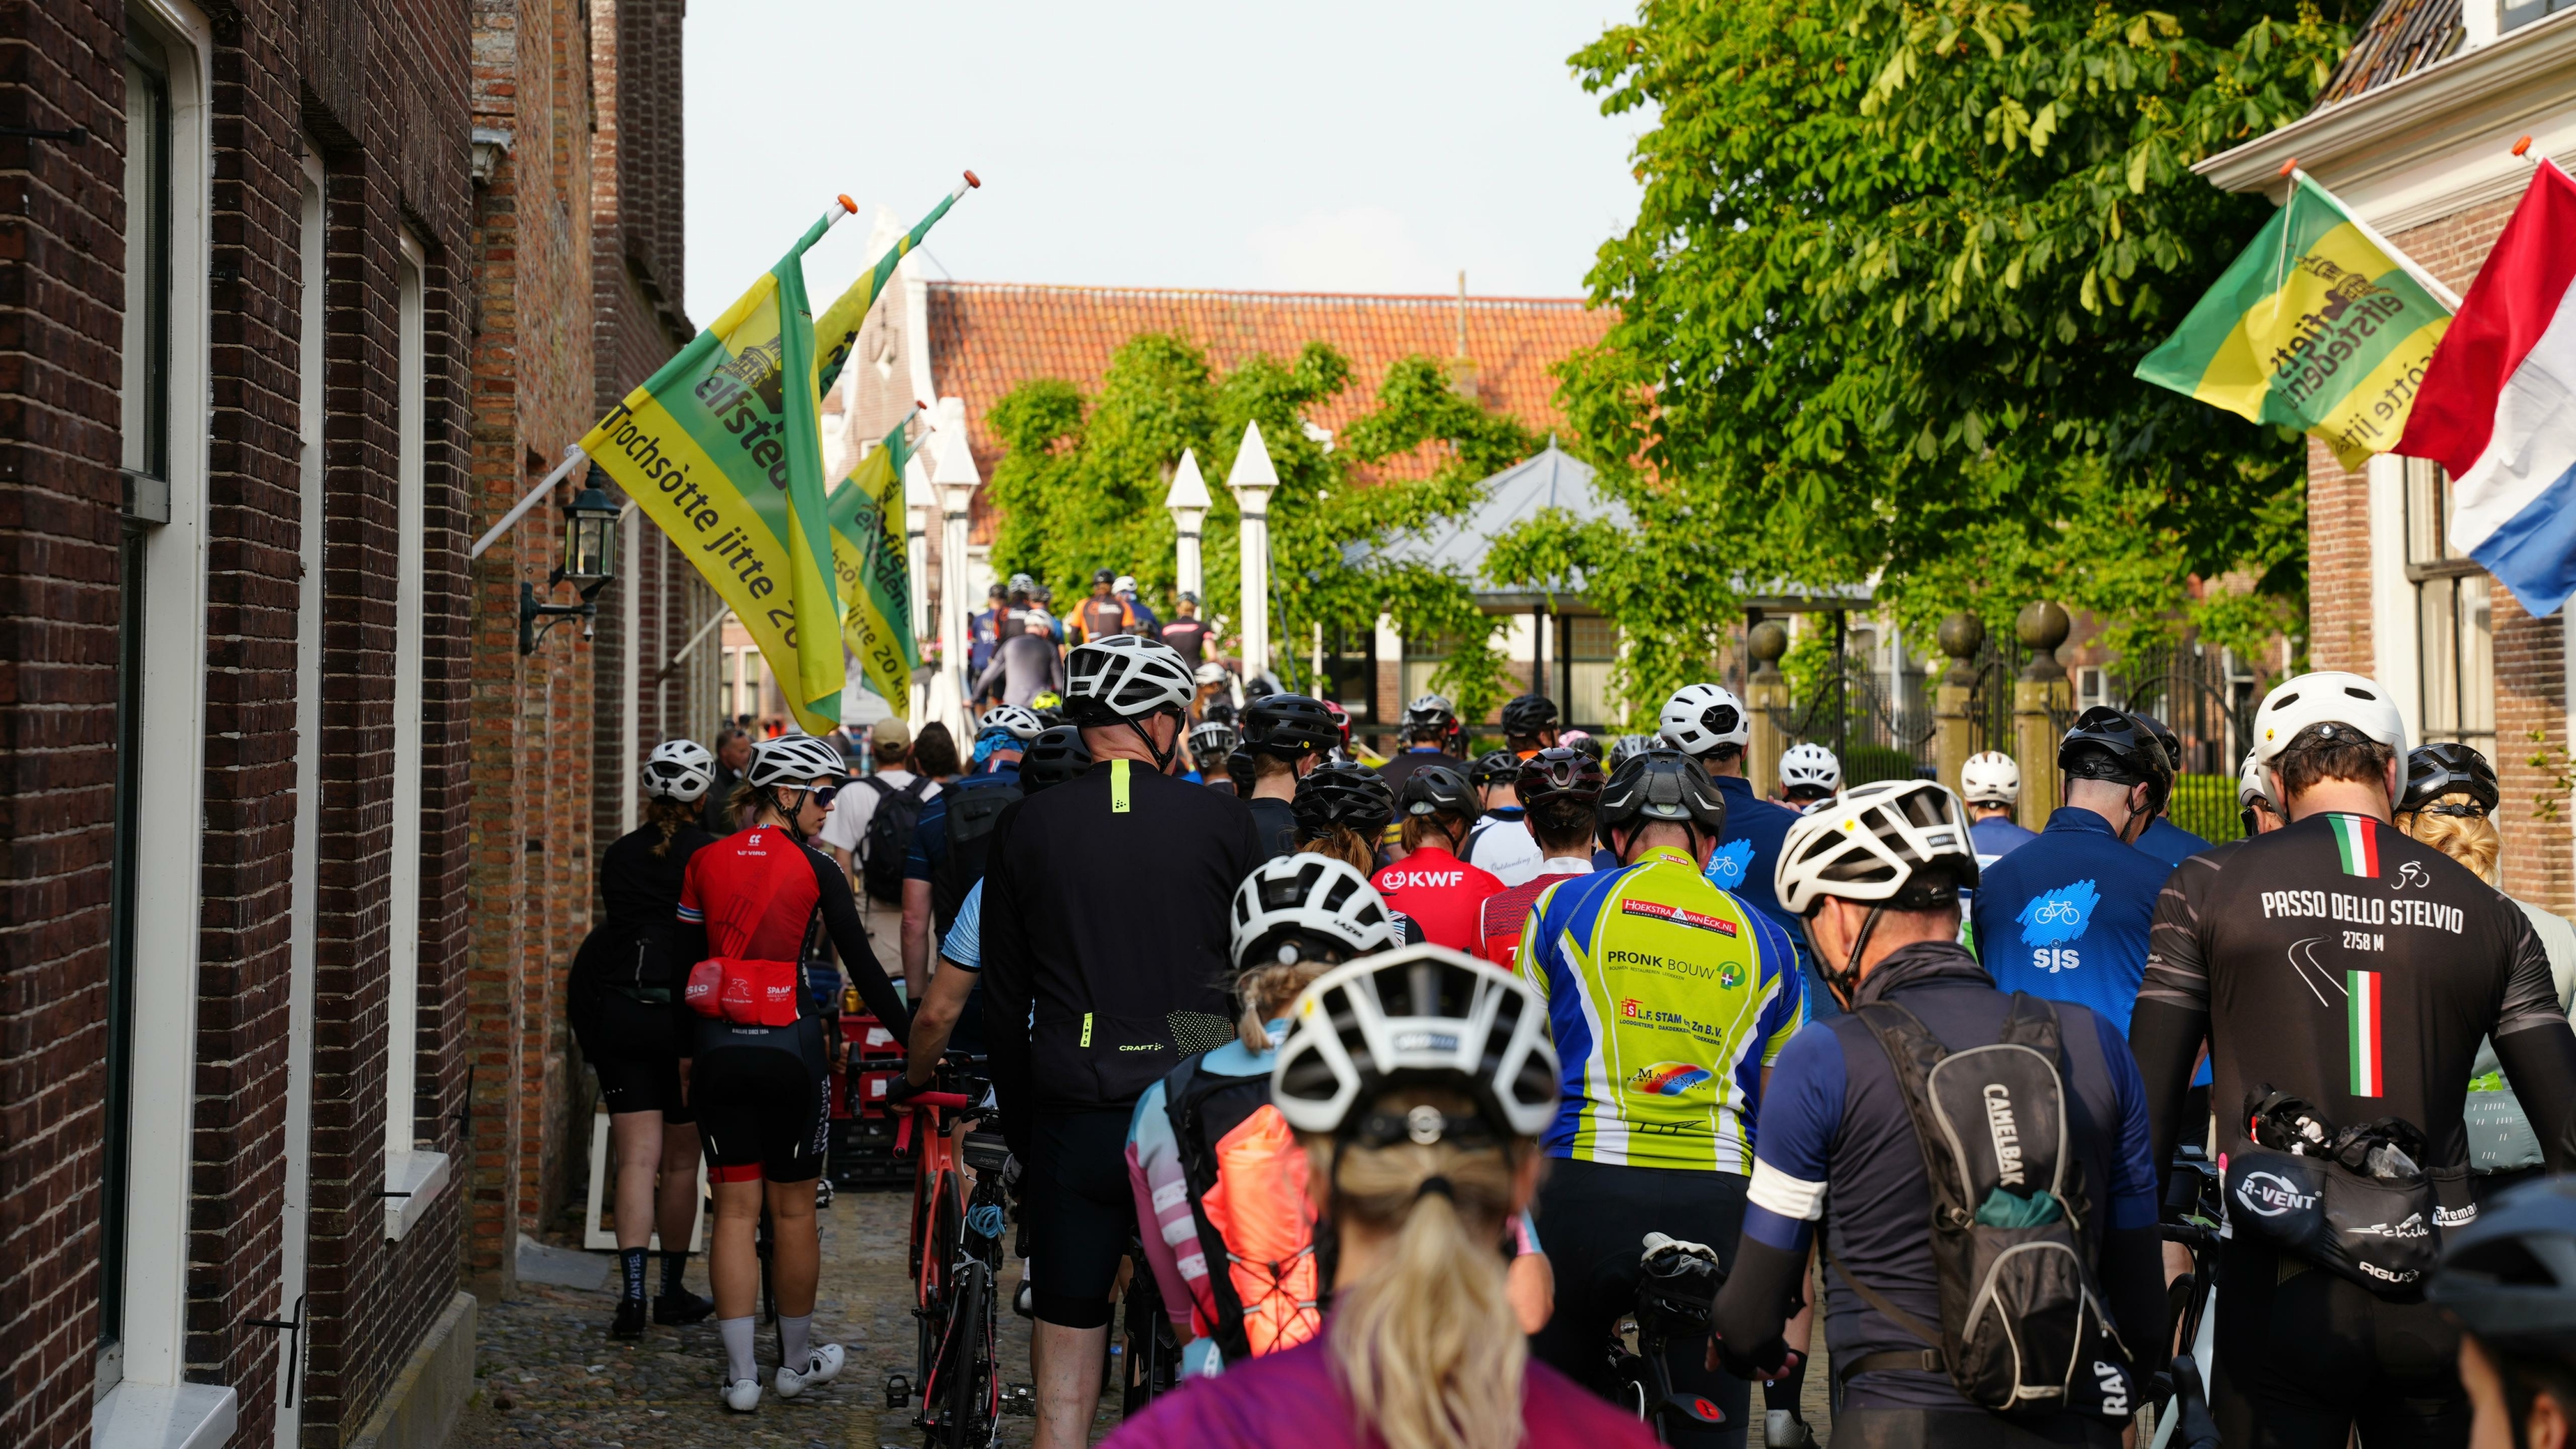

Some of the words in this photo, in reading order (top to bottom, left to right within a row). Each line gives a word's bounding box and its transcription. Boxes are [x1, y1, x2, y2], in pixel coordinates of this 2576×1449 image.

[600, 401, 719, 533] Trochsòtte
[703, 526, 773, 600] jitte
[1135, 652, 1162, 663] SPECIALIZED
[872, 645, 898, 675] 20
[891, 675, 909, 709] km
[1408, 871, 1464, 887] KWF
[2260, 890, 2327, 919] PASSO
[2330, 892, 2385, 925] DELLO
[2390, 899, 2464, 934] STELVIO
[2342, 931, 2371, 951] 2758
[2373, 934, 2384, 952] M
[1607, 951, 1663, 968] PRONK
[1667, 959, 1715, 980] BOUW
[1630, 967, 1660, 975] RESTAUREREN
[2032, 948, 2080, 974] sjs
[1619, 1019, 1654, 1030] LOODGIETERS
[1693, 1034, 1720, 1046] EIDEKKERS
[1638, 1009, 1653, 1021] L.F.
[1655, 1011, 1681, 1024] STAM
[1691, 1021, 1703, 1033] Zn
[1705, 1025, 1722, 1038] B.V.
[1637, 1068, 1698, 1086] MATENA
[1983, 1083, 2025, 1188] CAMELBAK
[2359, 1260, 2403, 1283] AGU
